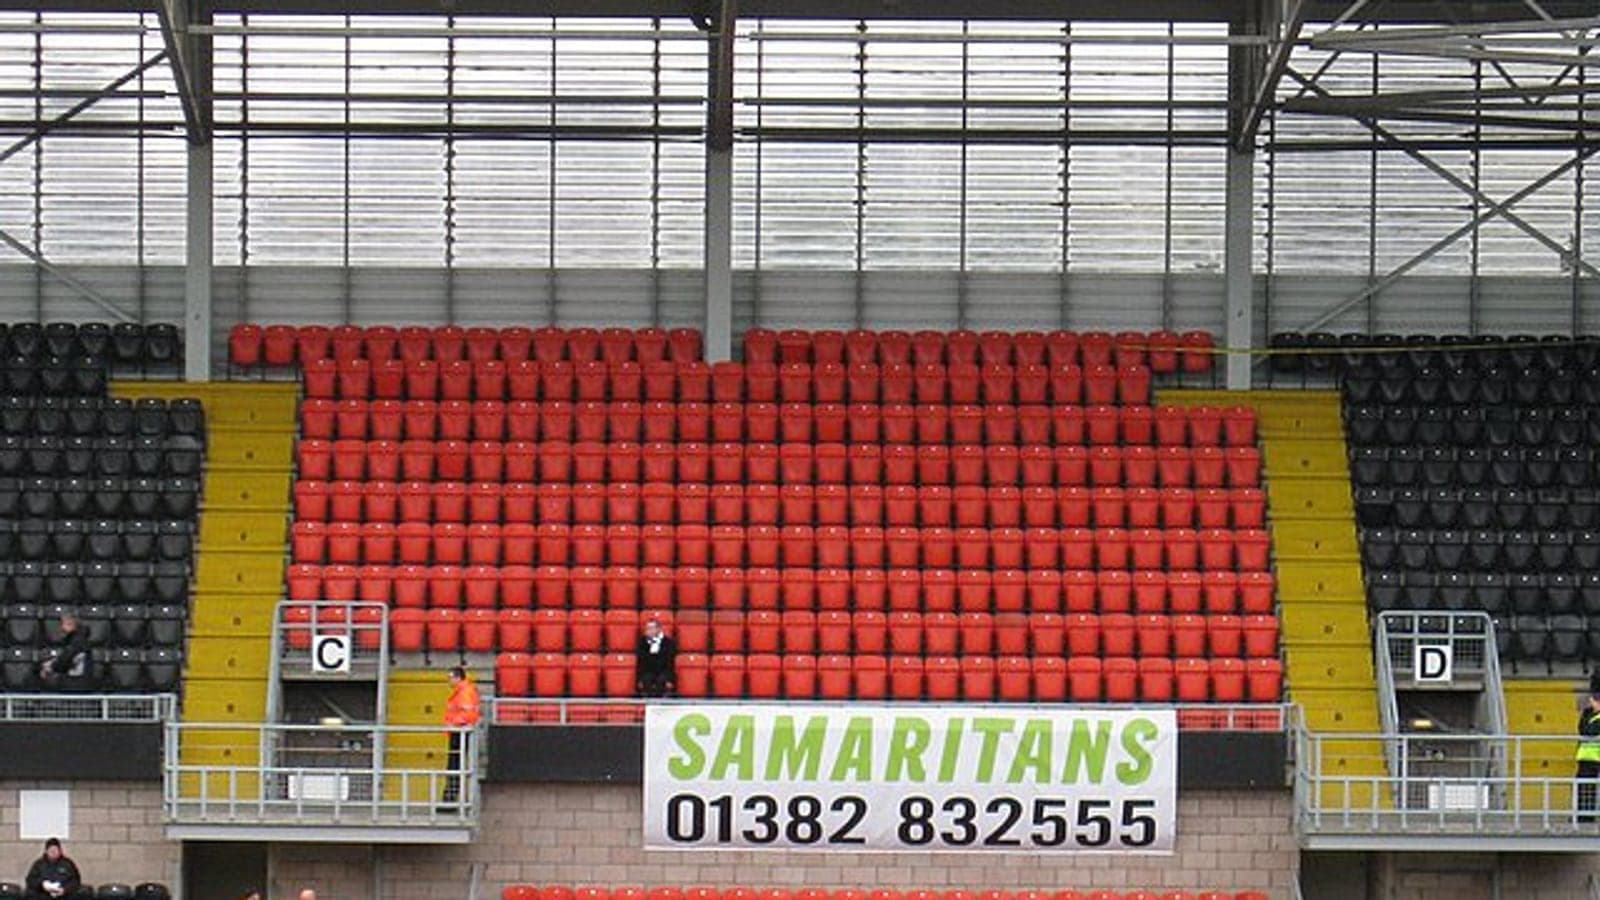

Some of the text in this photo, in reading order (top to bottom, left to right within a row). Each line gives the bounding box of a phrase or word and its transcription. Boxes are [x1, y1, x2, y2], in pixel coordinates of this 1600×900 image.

[316, 637, 345, 670] C
[1419, 647, 1447, 680] D
[667, 712, 1159, 786] SAMARITANS
[666, 793, 1157, 847] 01382 832555
